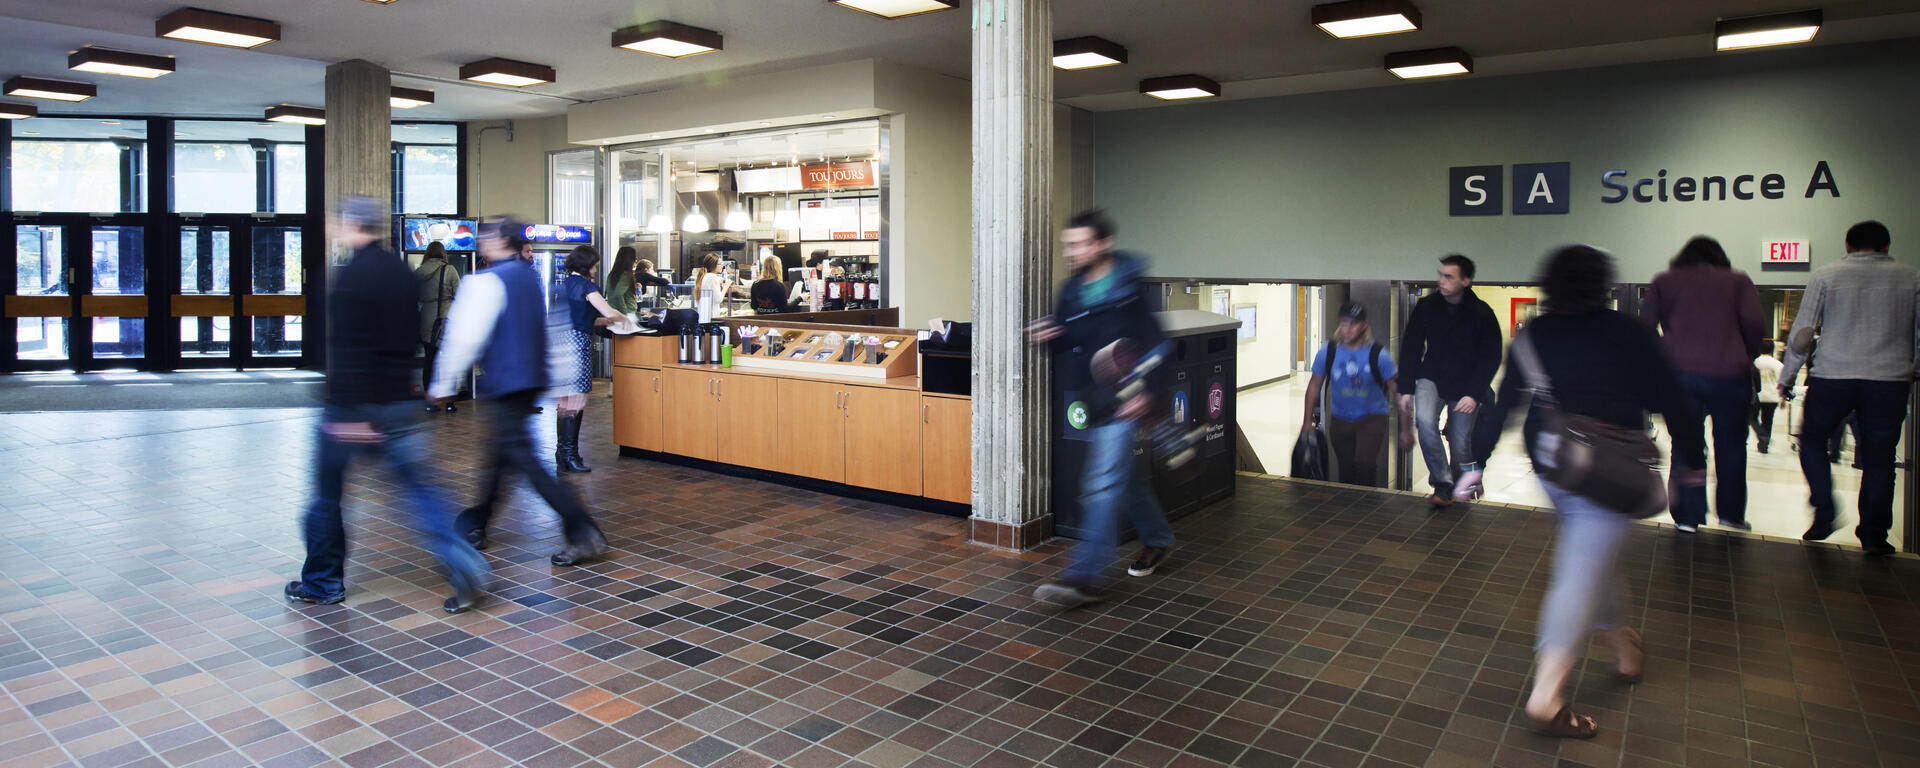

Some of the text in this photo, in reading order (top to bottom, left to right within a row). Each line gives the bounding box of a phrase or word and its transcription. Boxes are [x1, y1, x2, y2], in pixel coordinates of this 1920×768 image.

[1464, 175, 1487, 206] S
[1527, 172, 1554, 204] A
[1601, 160, 1840, 204] Science A
[1770, 242, 1800, 261] EXIT
